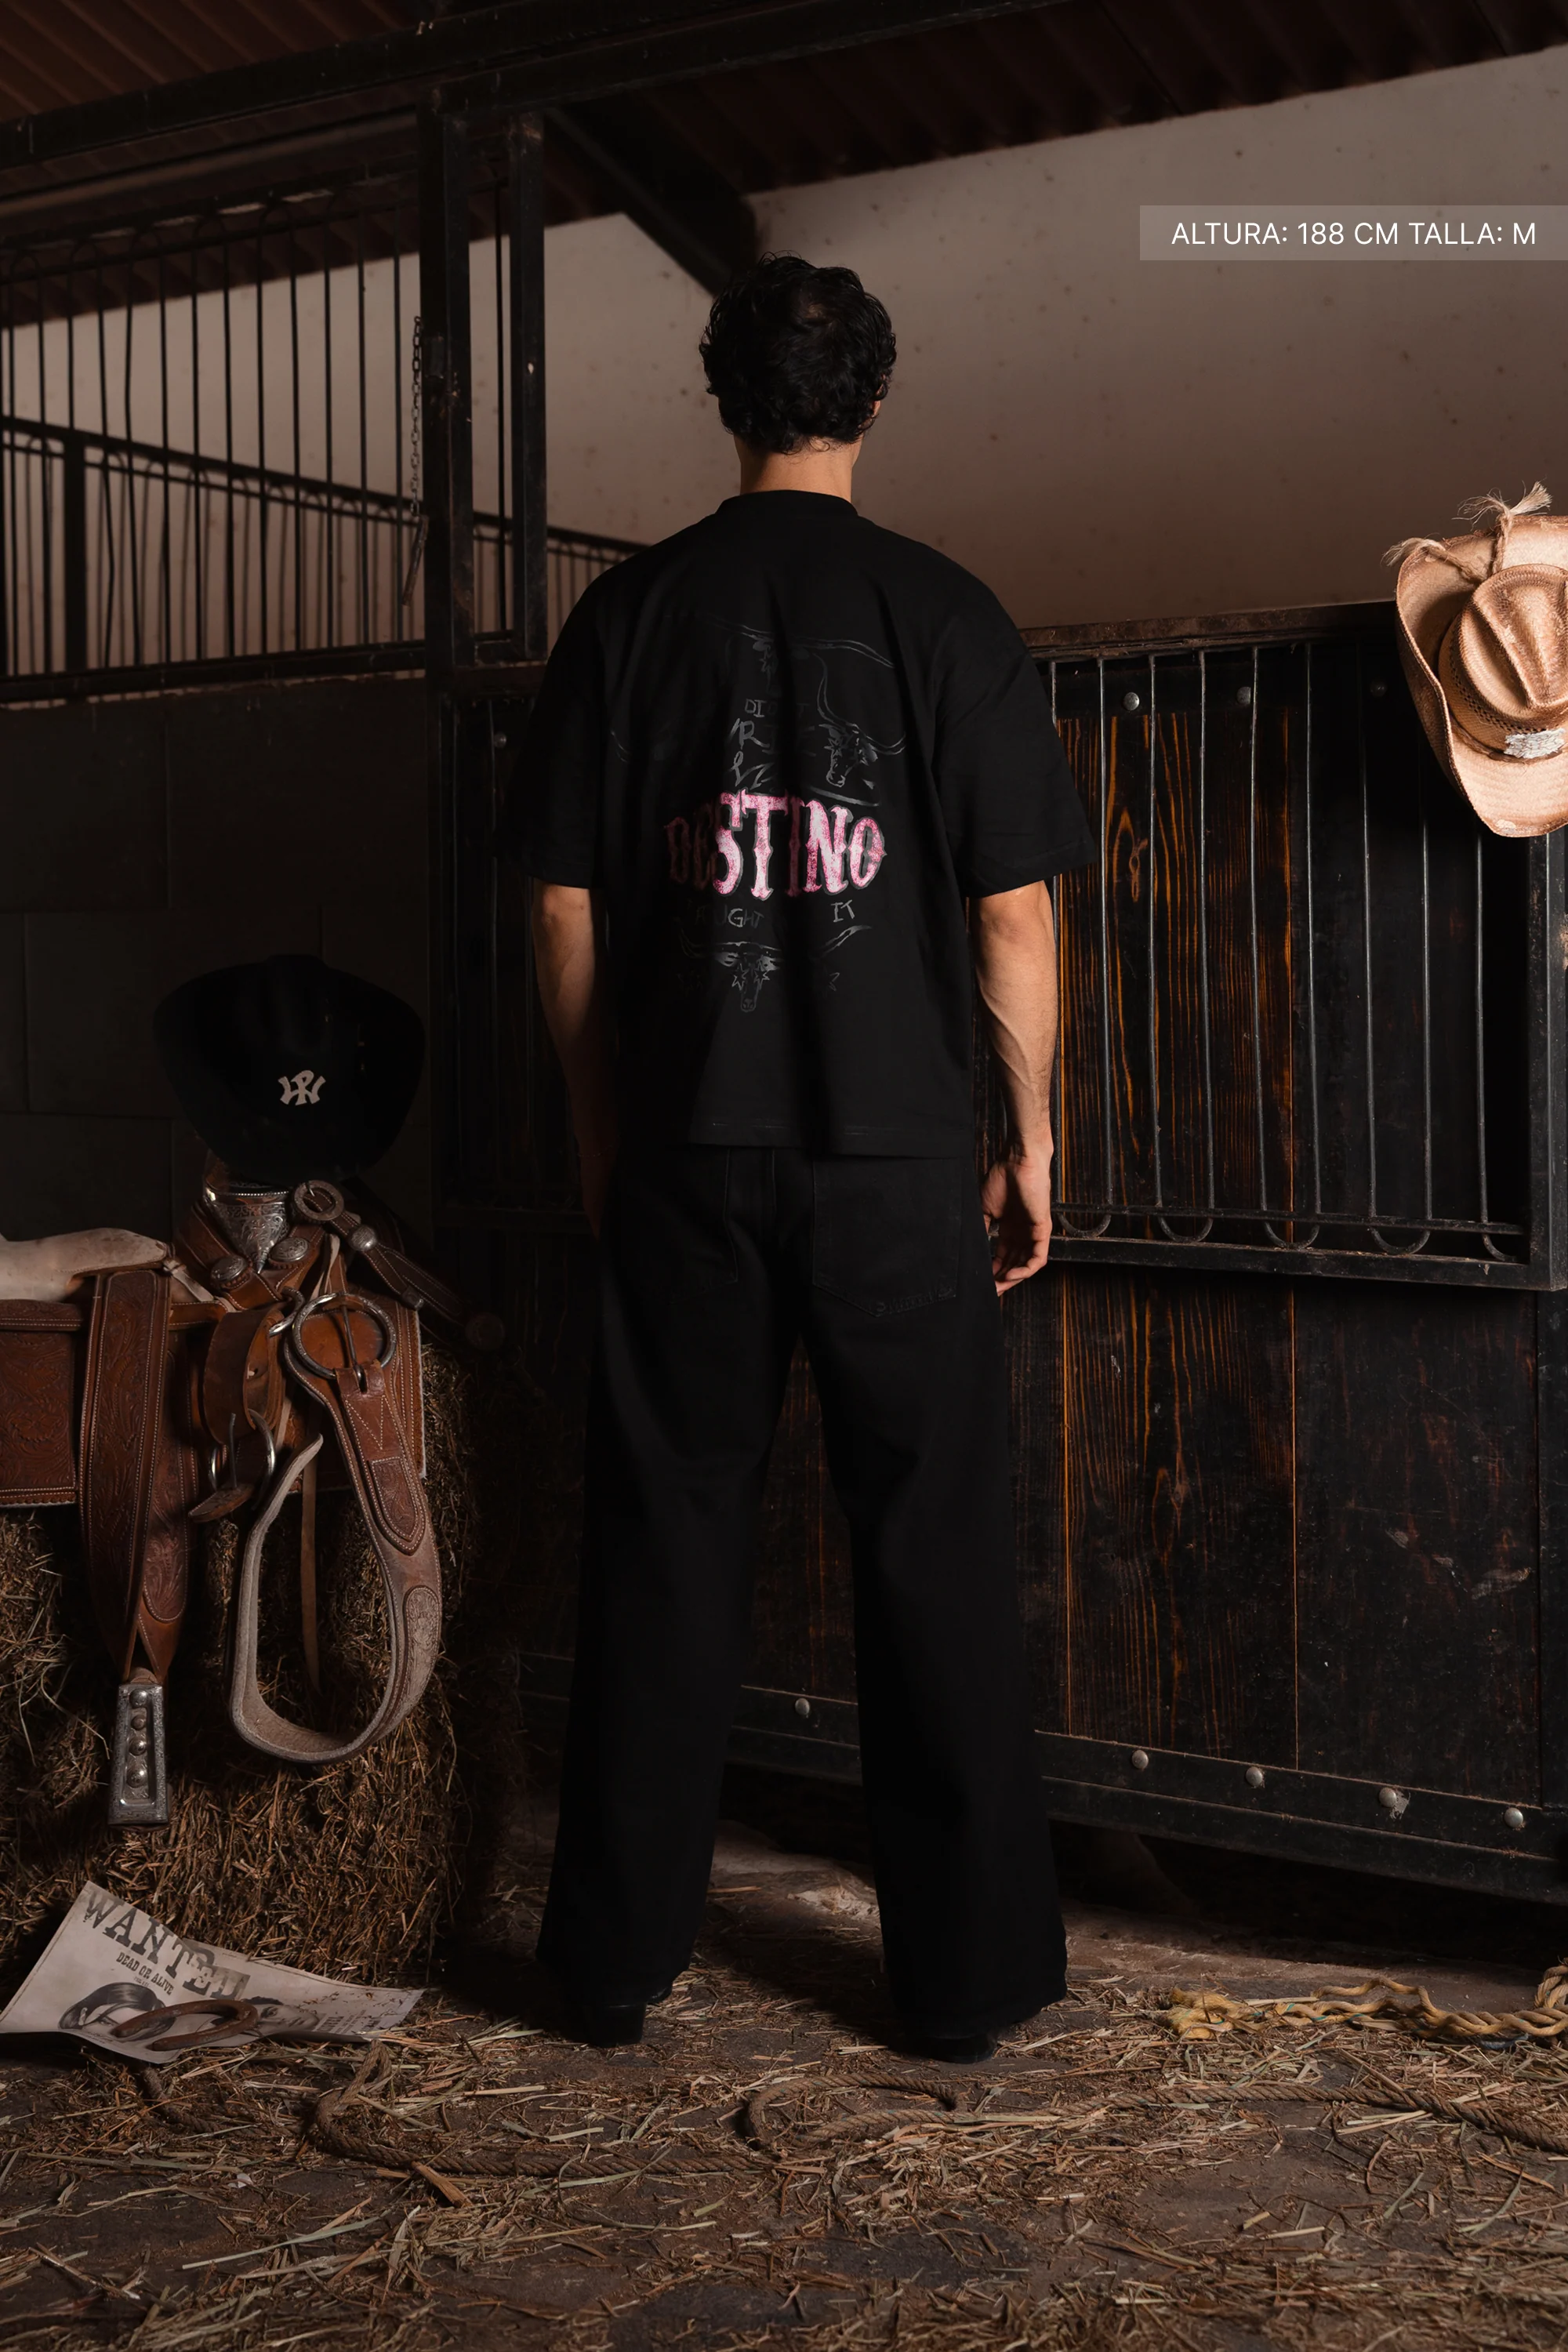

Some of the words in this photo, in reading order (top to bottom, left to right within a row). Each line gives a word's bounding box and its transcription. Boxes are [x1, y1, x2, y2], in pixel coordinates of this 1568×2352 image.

[663, 789, 887, 901] DESTINO
[116, 1951, 140, 1972] DEAD
[138, 1965, 152, 1980] OR
[151, 1973, 174, 1996] ALIVE
